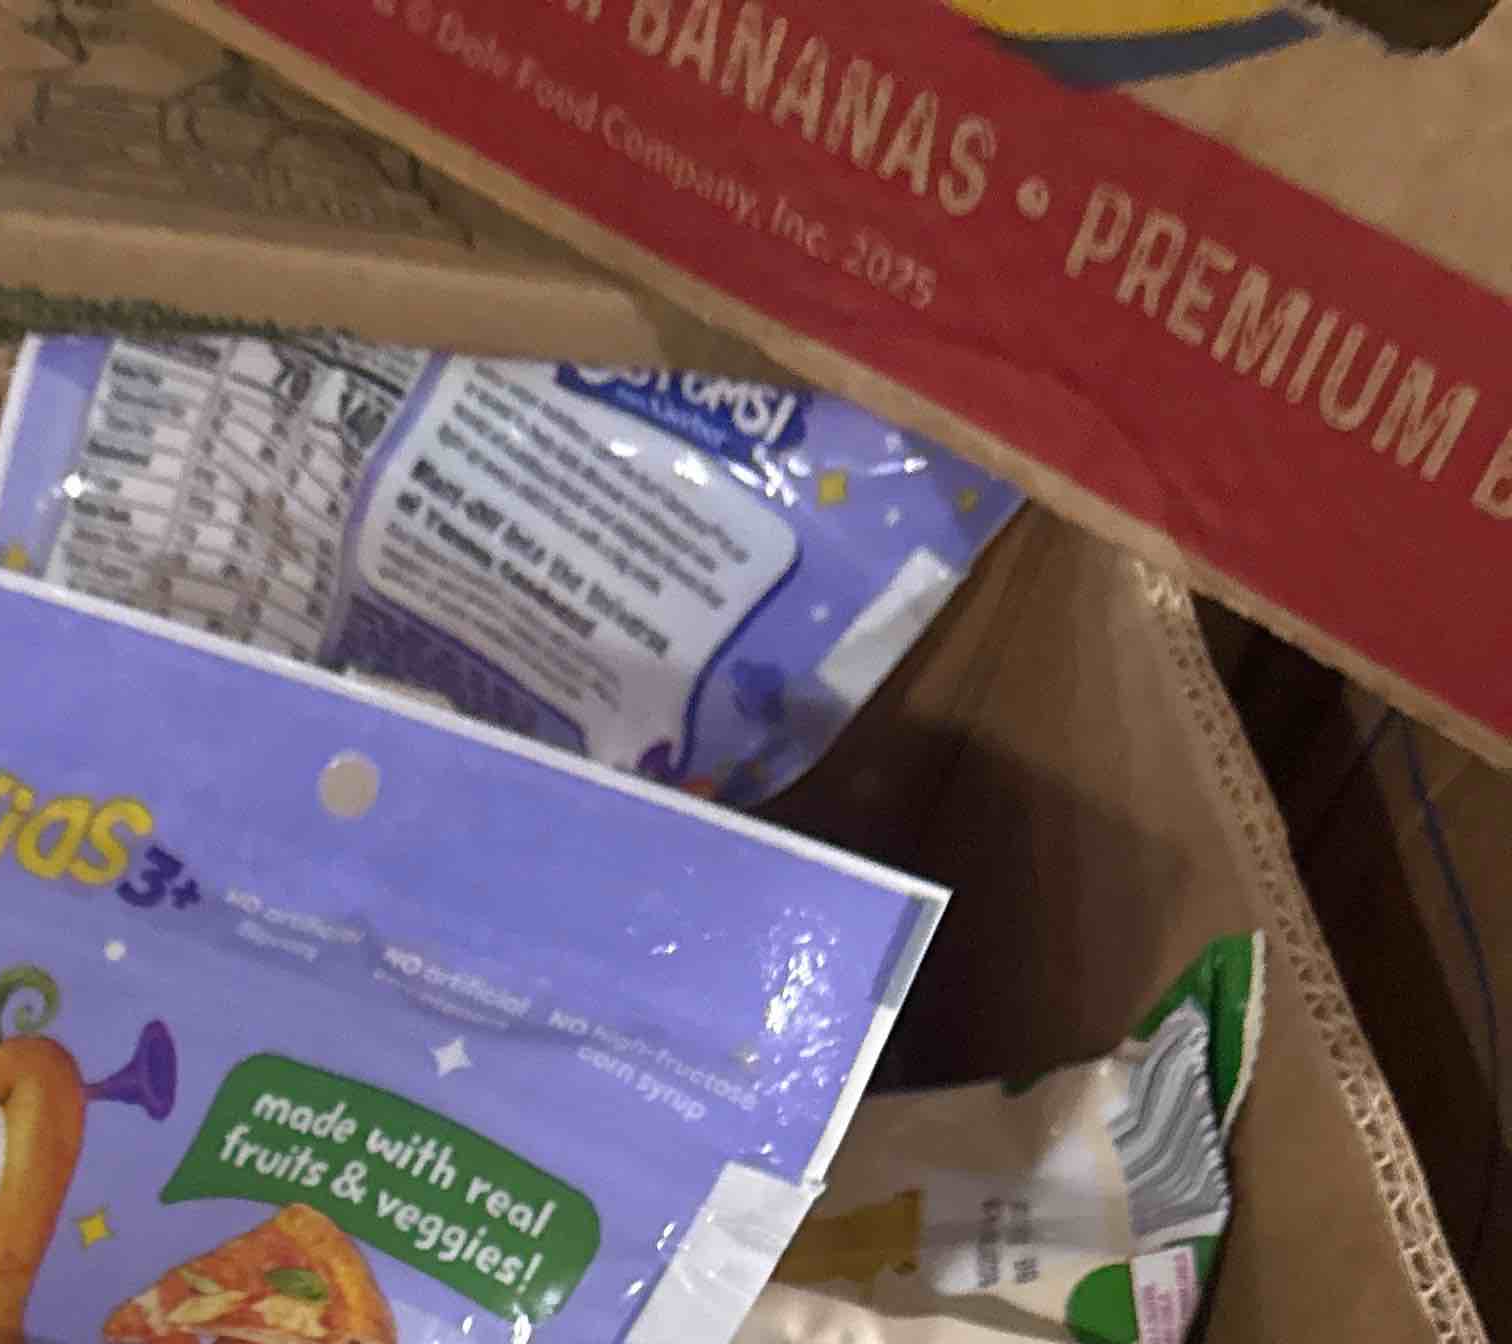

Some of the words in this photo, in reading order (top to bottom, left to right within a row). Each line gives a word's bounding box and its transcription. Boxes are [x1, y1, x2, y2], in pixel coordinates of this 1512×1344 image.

[437, 12, 512, 78] Dole
[514, 56, 599, 131] Food
[601, 106, 761, 229] Company,
[770, 198, 831, 261] Inc.
[841, 233, 938, 309] 2025
[627, 0, 996, 217] BANANAS
[1064, 183, 1481, 481] PREMIUM
[116, 843, 201, 911] 3+
[384, 945, 424, 977] NO
[549, 1009, 588, 1036] NO
[576, 1043, 628, 1079] corn
[629, 1068, 706, 1122] syrup
[220, 1123, 323, 1190] fruits
[329, 1160, 367, 1205] &
[378, 1189, 544, 1294] veggies!
[253, 1092, 357, 1144] made
[367, 1128, 456, 1190] with
[466, 1176, 557, 1238] real
